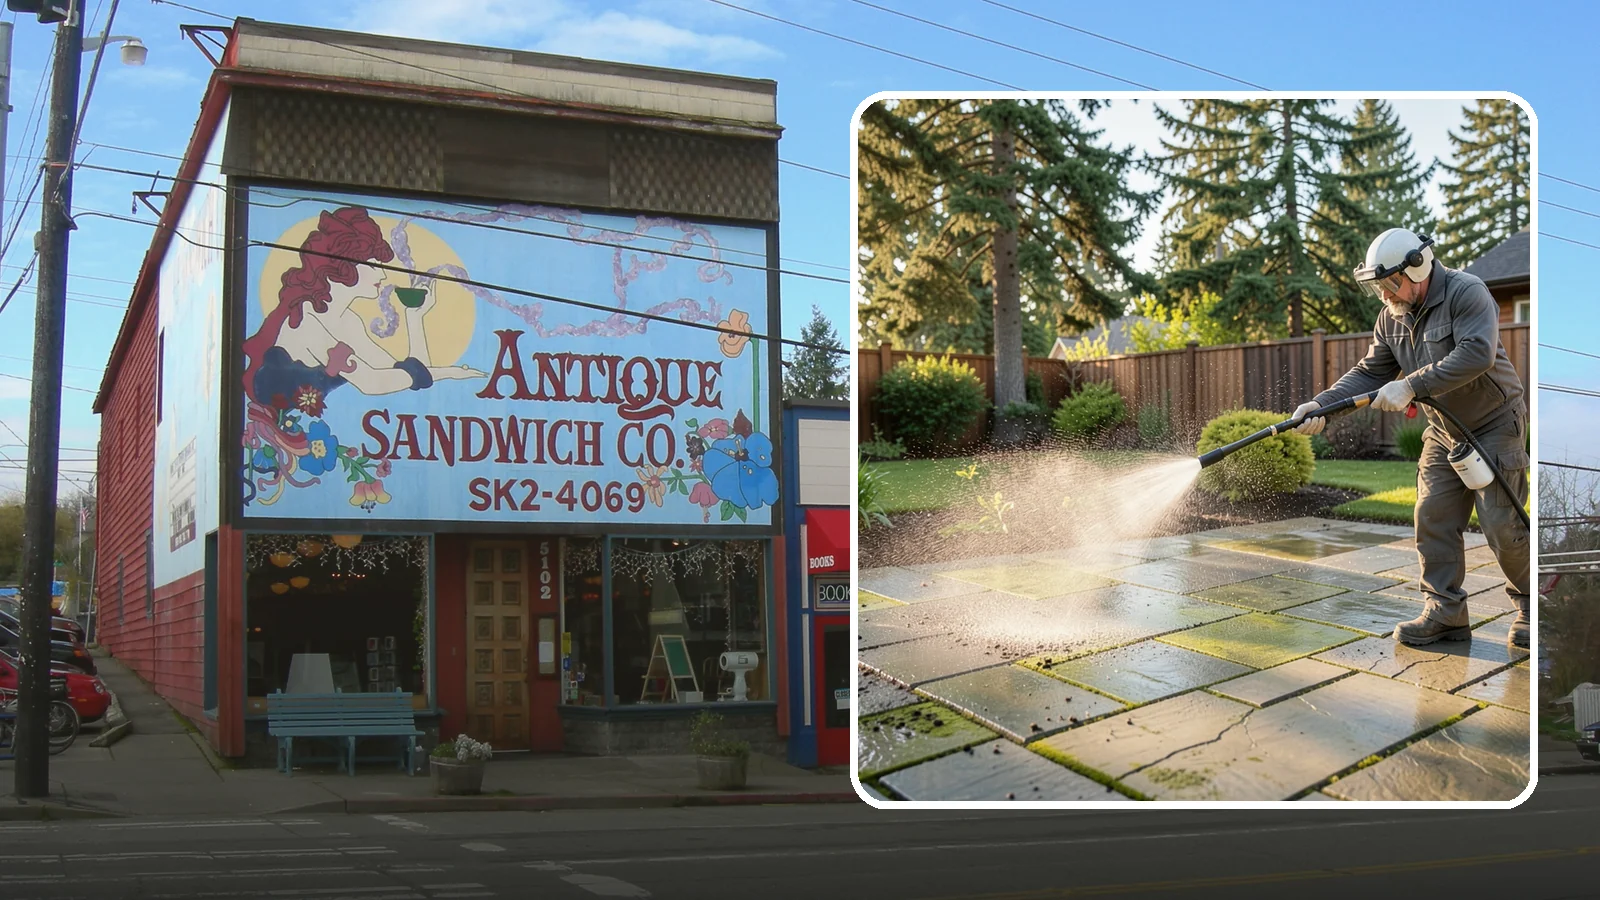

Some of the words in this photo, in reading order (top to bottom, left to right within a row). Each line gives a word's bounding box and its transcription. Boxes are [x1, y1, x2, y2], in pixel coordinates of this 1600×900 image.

[475, 329, 723, 420] ANTIQUE
[361, 408, 604, 468] SANDWICH
[617, 421, 684, 469] CO.
[468, 477, 645, 513] SK2-4069
[540, 541, 551, 600] 5102
[809, 555, 835, 568] BOOKS
